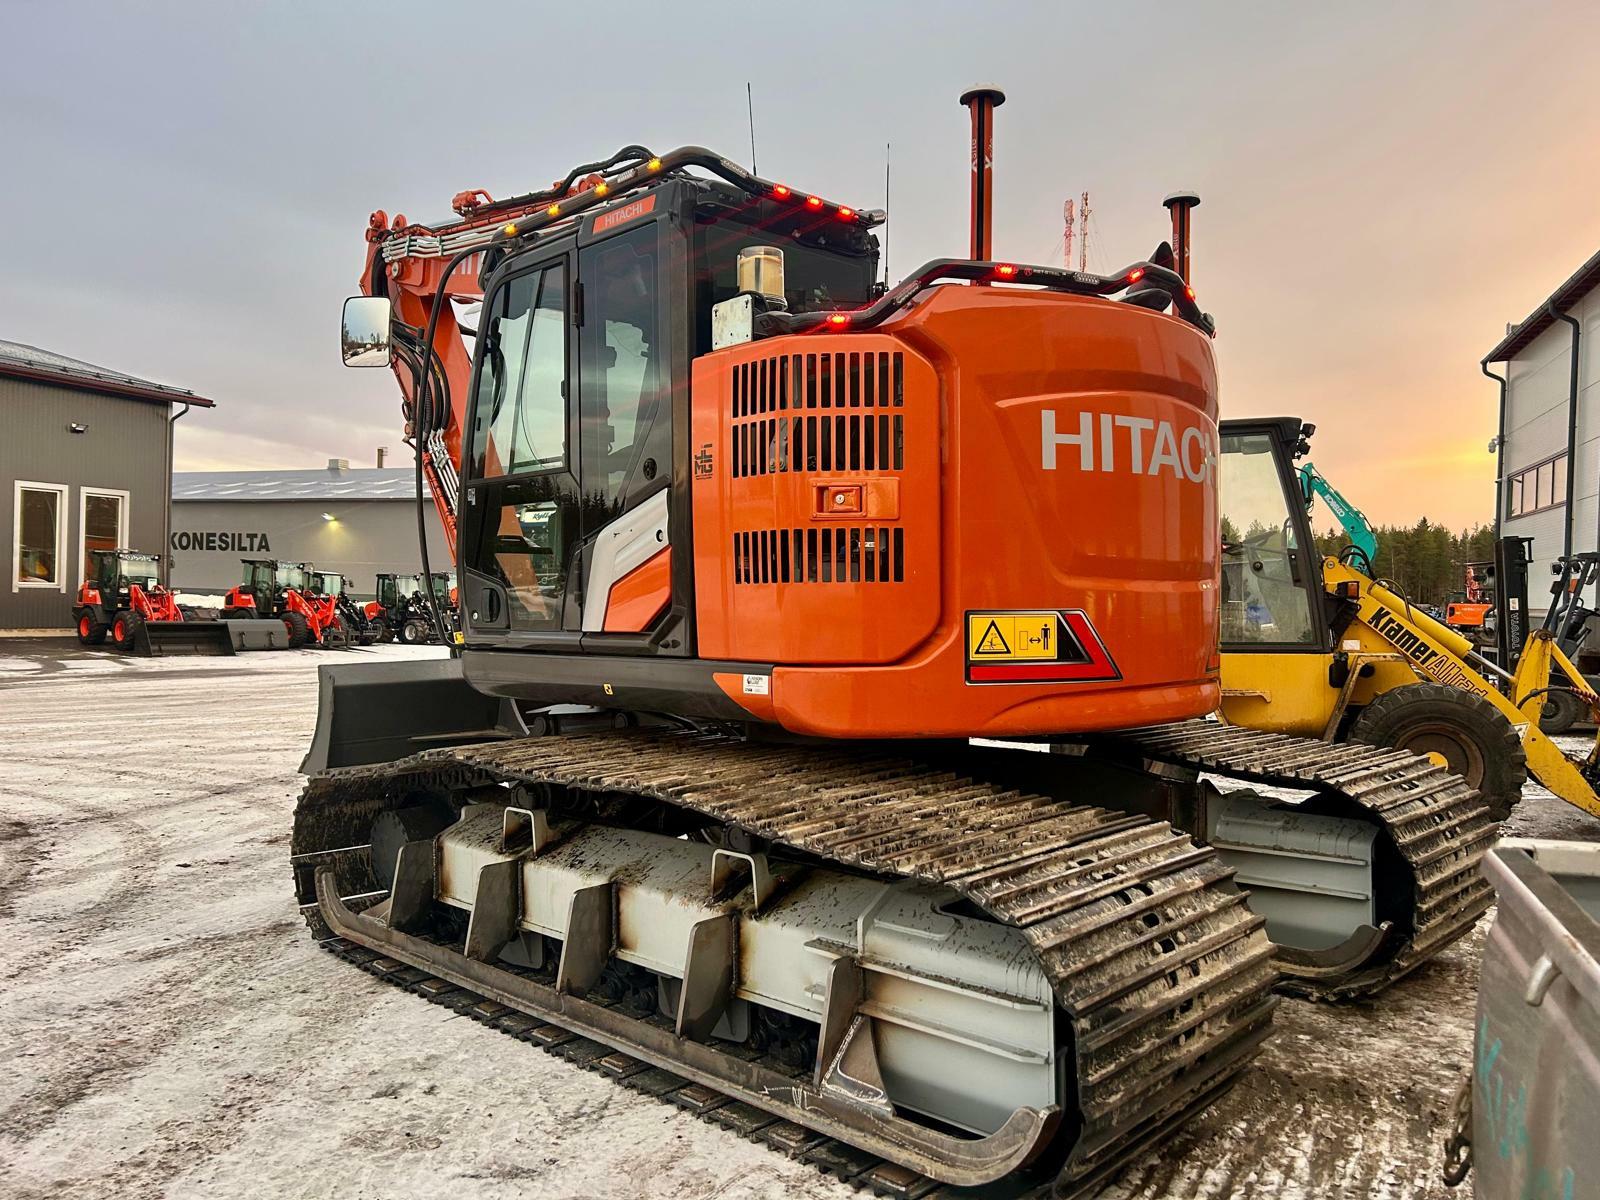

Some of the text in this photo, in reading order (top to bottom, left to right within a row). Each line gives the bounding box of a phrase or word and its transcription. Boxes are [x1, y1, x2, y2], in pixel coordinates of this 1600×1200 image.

[604, 203, 642, 226] HITACHI
[1368, 606, 1439, 666] Kramer
[1511, 613, 1520, 649] TOYOTA
